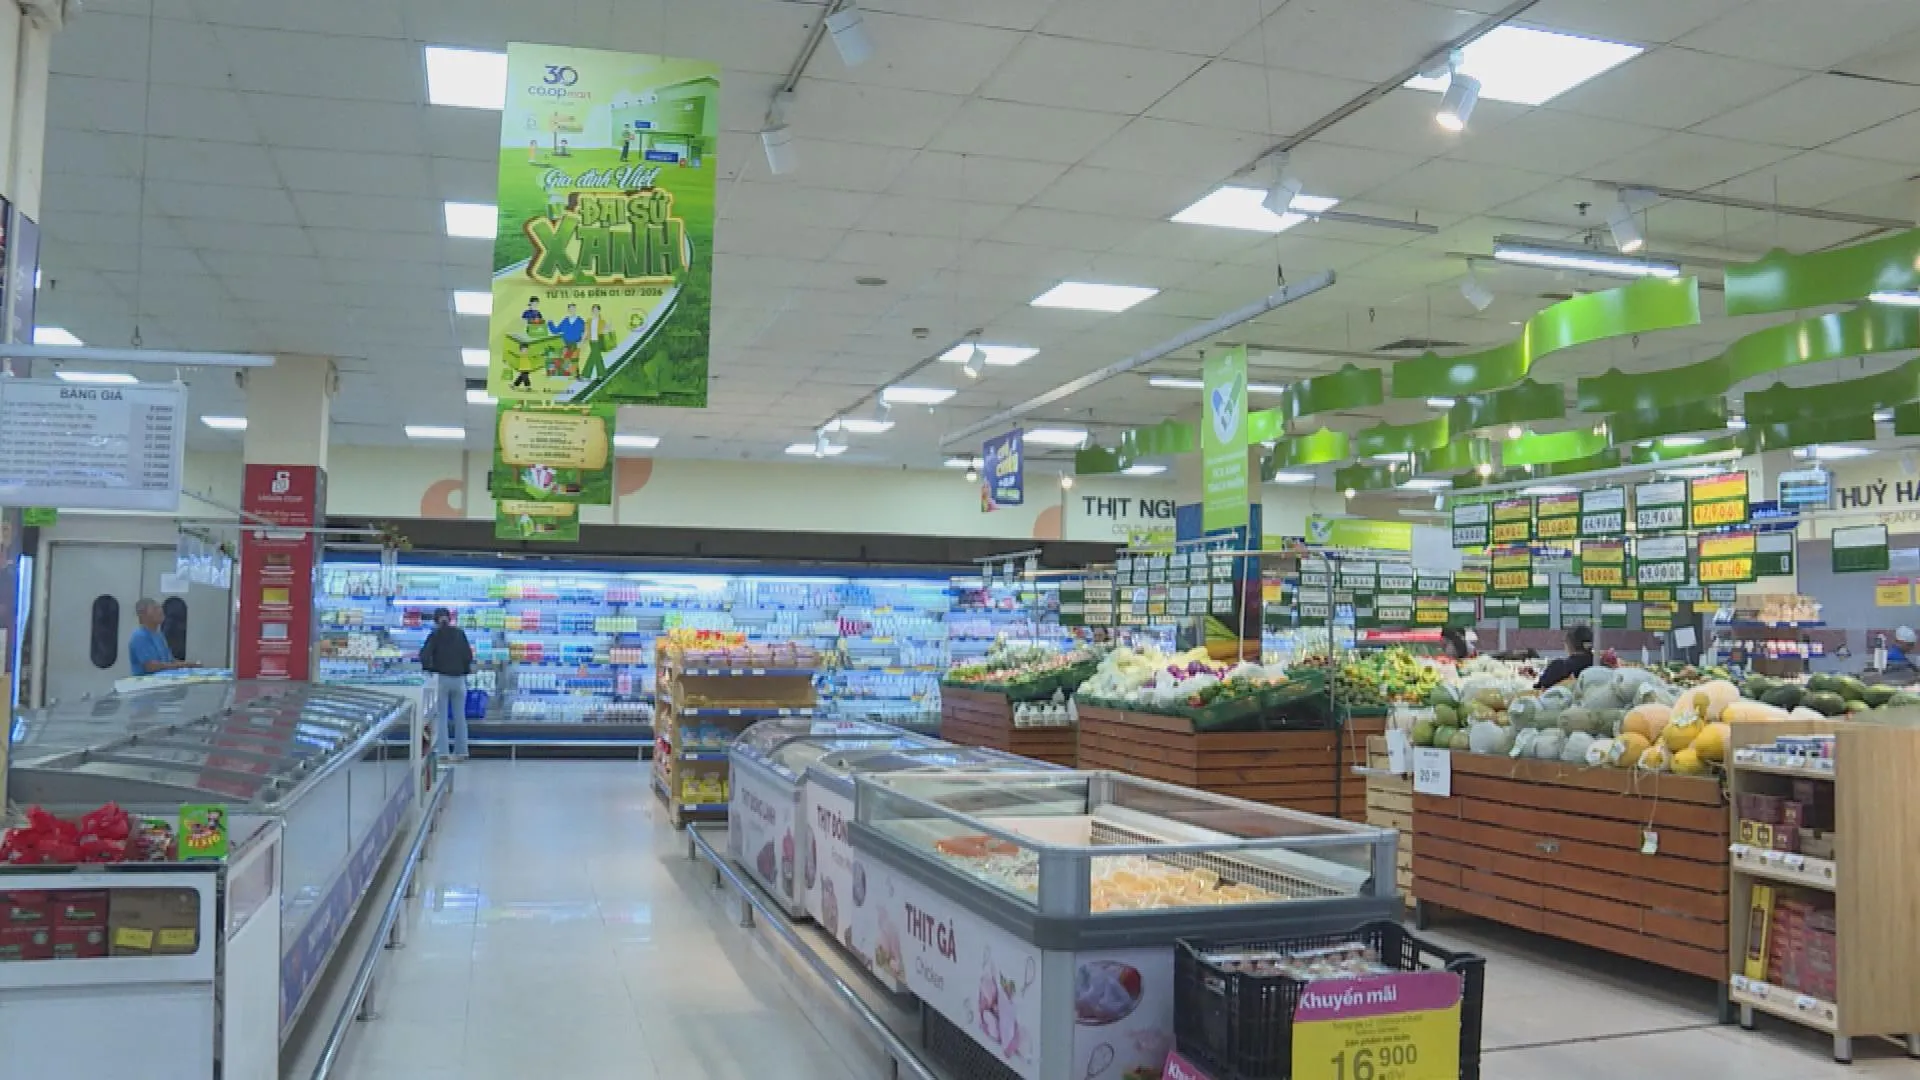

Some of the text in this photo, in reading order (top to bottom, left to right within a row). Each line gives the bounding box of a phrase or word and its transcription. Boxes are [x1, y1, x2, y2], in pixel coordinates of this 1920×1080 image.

[545, 163, 661, 190] Gia đình Việt
[581, 190, 668, 228] ĐẠI SỨ
[531, 214, 681, 278] XANH
[1082, 495, 1132, 520] THỊT
[904, 902, 936, 953] THỊT
[1299, 986, 1363, 1012] Khuyến
[1330, 1043, 1418, 1080] 16 900
